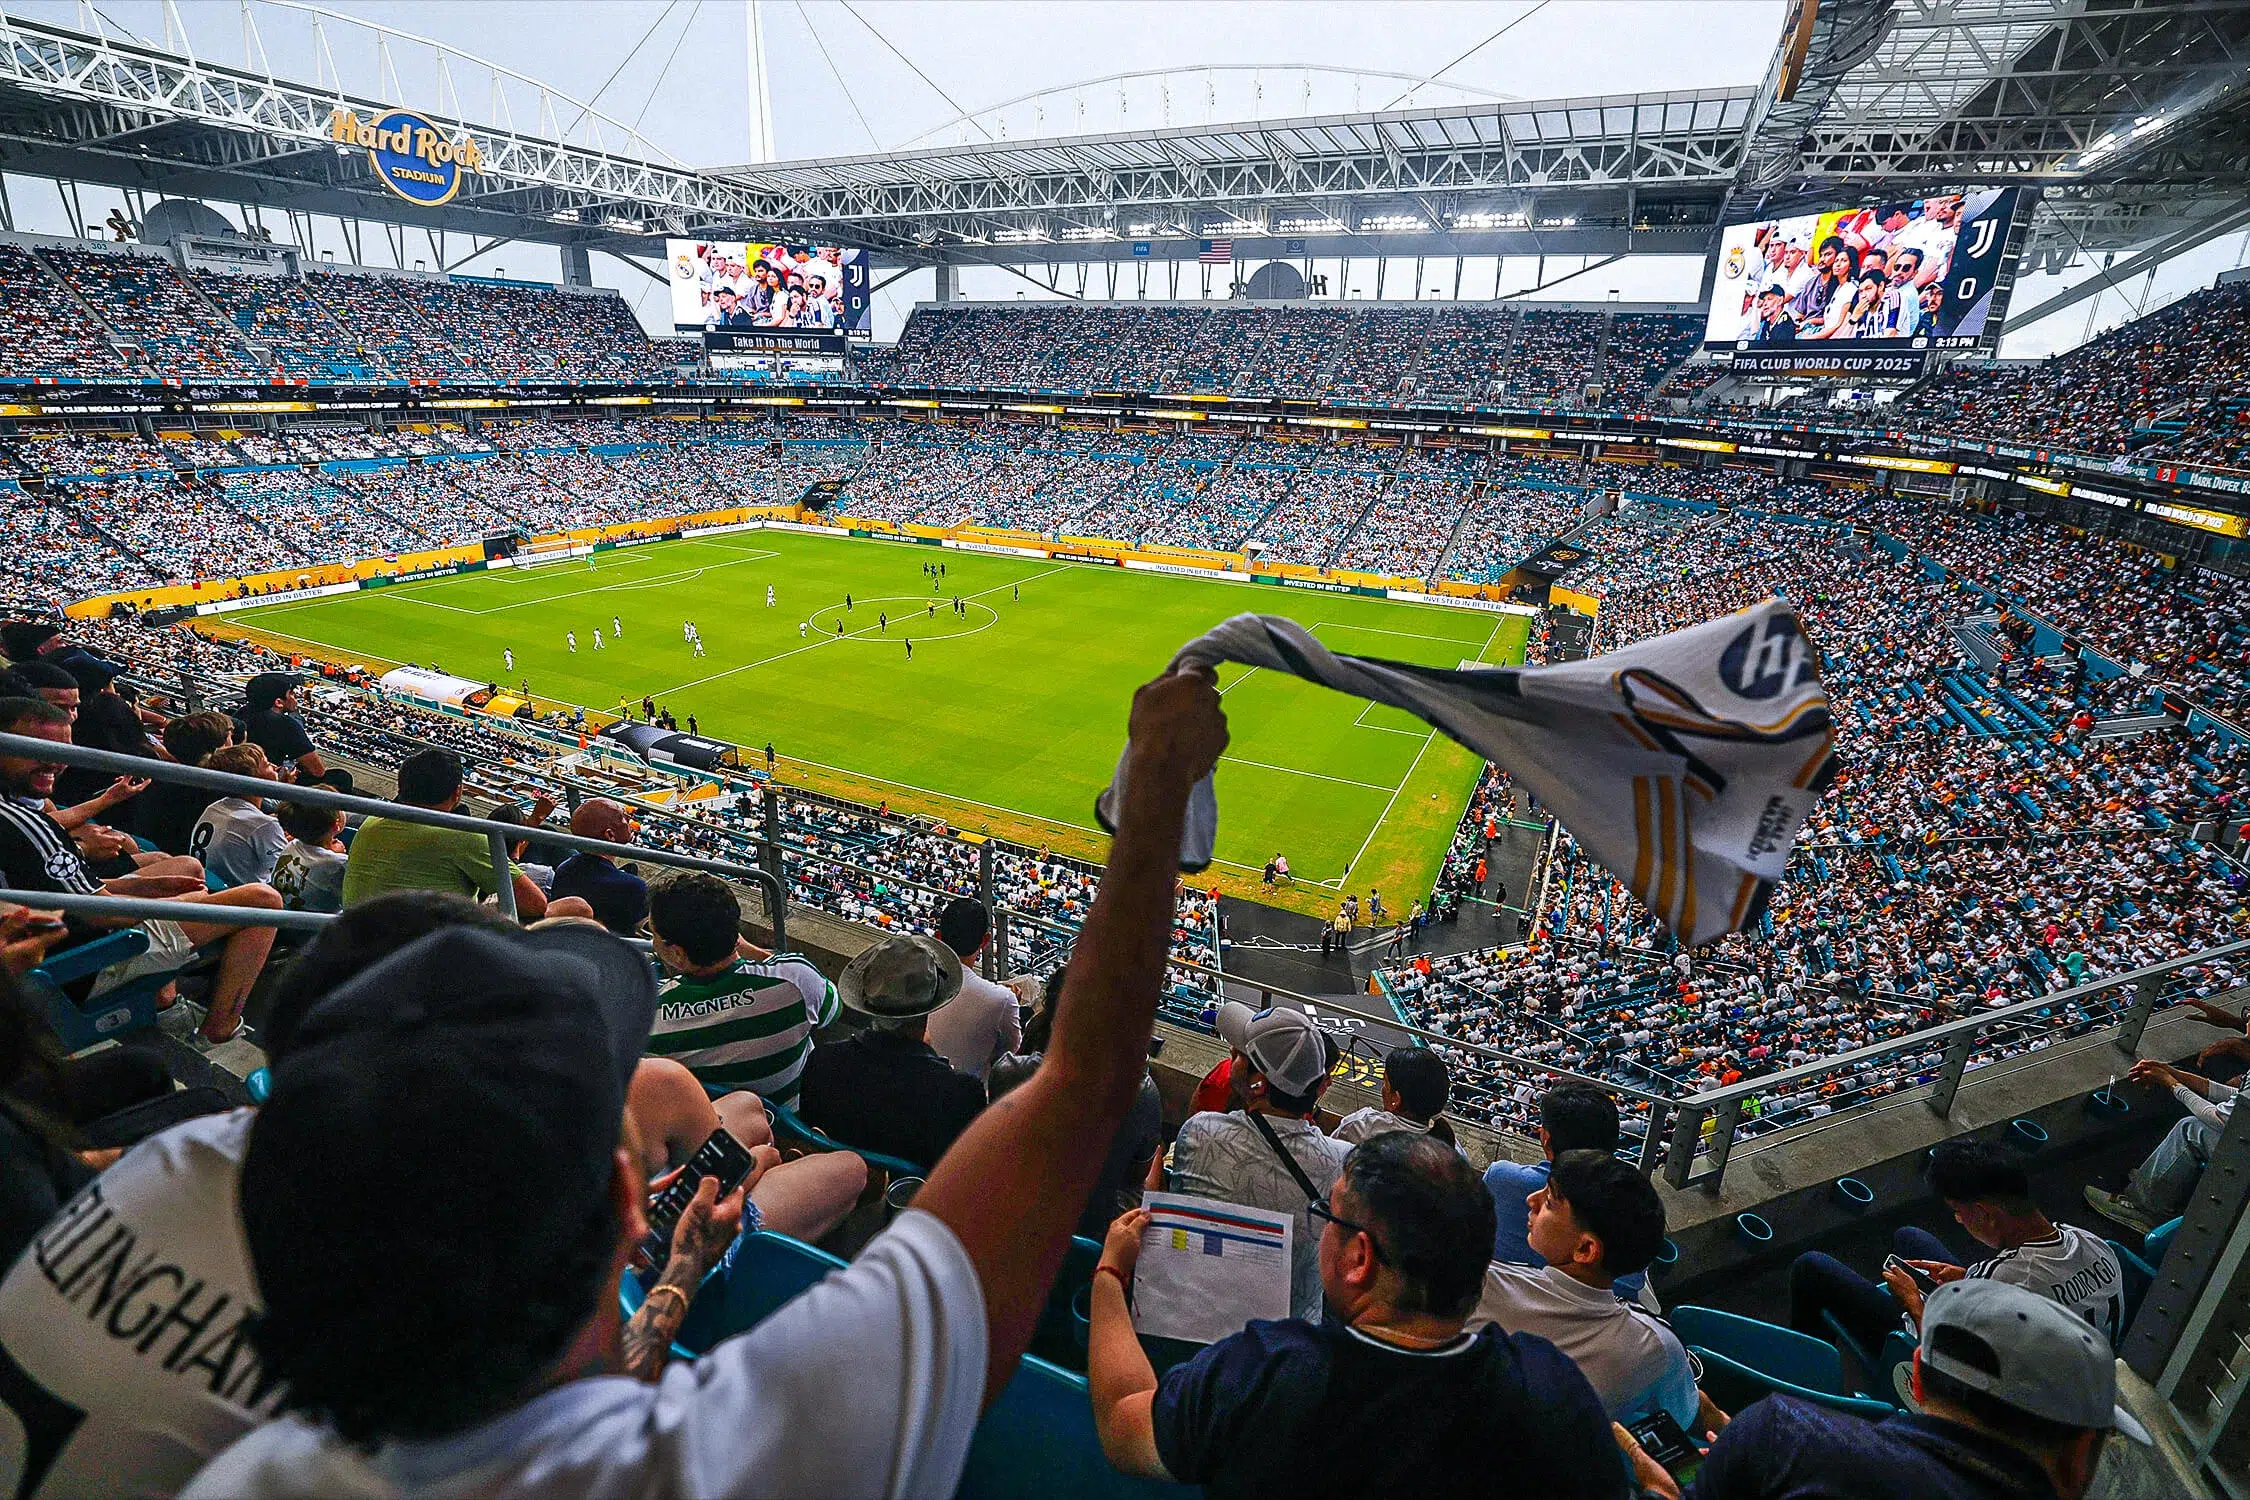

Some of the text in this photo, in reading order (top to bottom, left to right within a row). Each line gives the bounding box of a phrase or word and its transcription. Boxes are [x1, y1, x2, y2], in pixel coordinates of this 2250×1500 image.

[330, 109, 486, 175] Hard Rock
[391, 166, 446, 186] STADIUM
[1135, 245, 1148, 253] FIFA
[1957, 277, 1977, 300] 0
[851, 296, 861, 309] 0
[732, 336, 820, 350] Take It To The World
[1959, 337, 1975, 347] PM
[1733, 358, 1758, 370] FIFA
[1760, 358, 1792, 370] CLUB
[1794, 357, 1842, 370] WORLD
[1843, 357, 1873, 370] CUP
[2190, 472, 2212, 488] MARK
[2212, 476, 2241, 493] DUPER
[394, 572, 426, 583] INVESTED
[434, 567, 459, 578] BETTER
[1283, 578, 1317, 590] INVESTED
[1325, 584, 1351, 593] BETTER
[240, 595, 283, 607] INVESTED
[293, 588, 324, 600] BETTER
[1423, 595, 1461, 606] INVESTED
[1472, 601, 1502, 611] BETTER
[662, 988, 757, 1021] MAGNERS
[2050, 1256, 2117, 1306] RODRYGO
